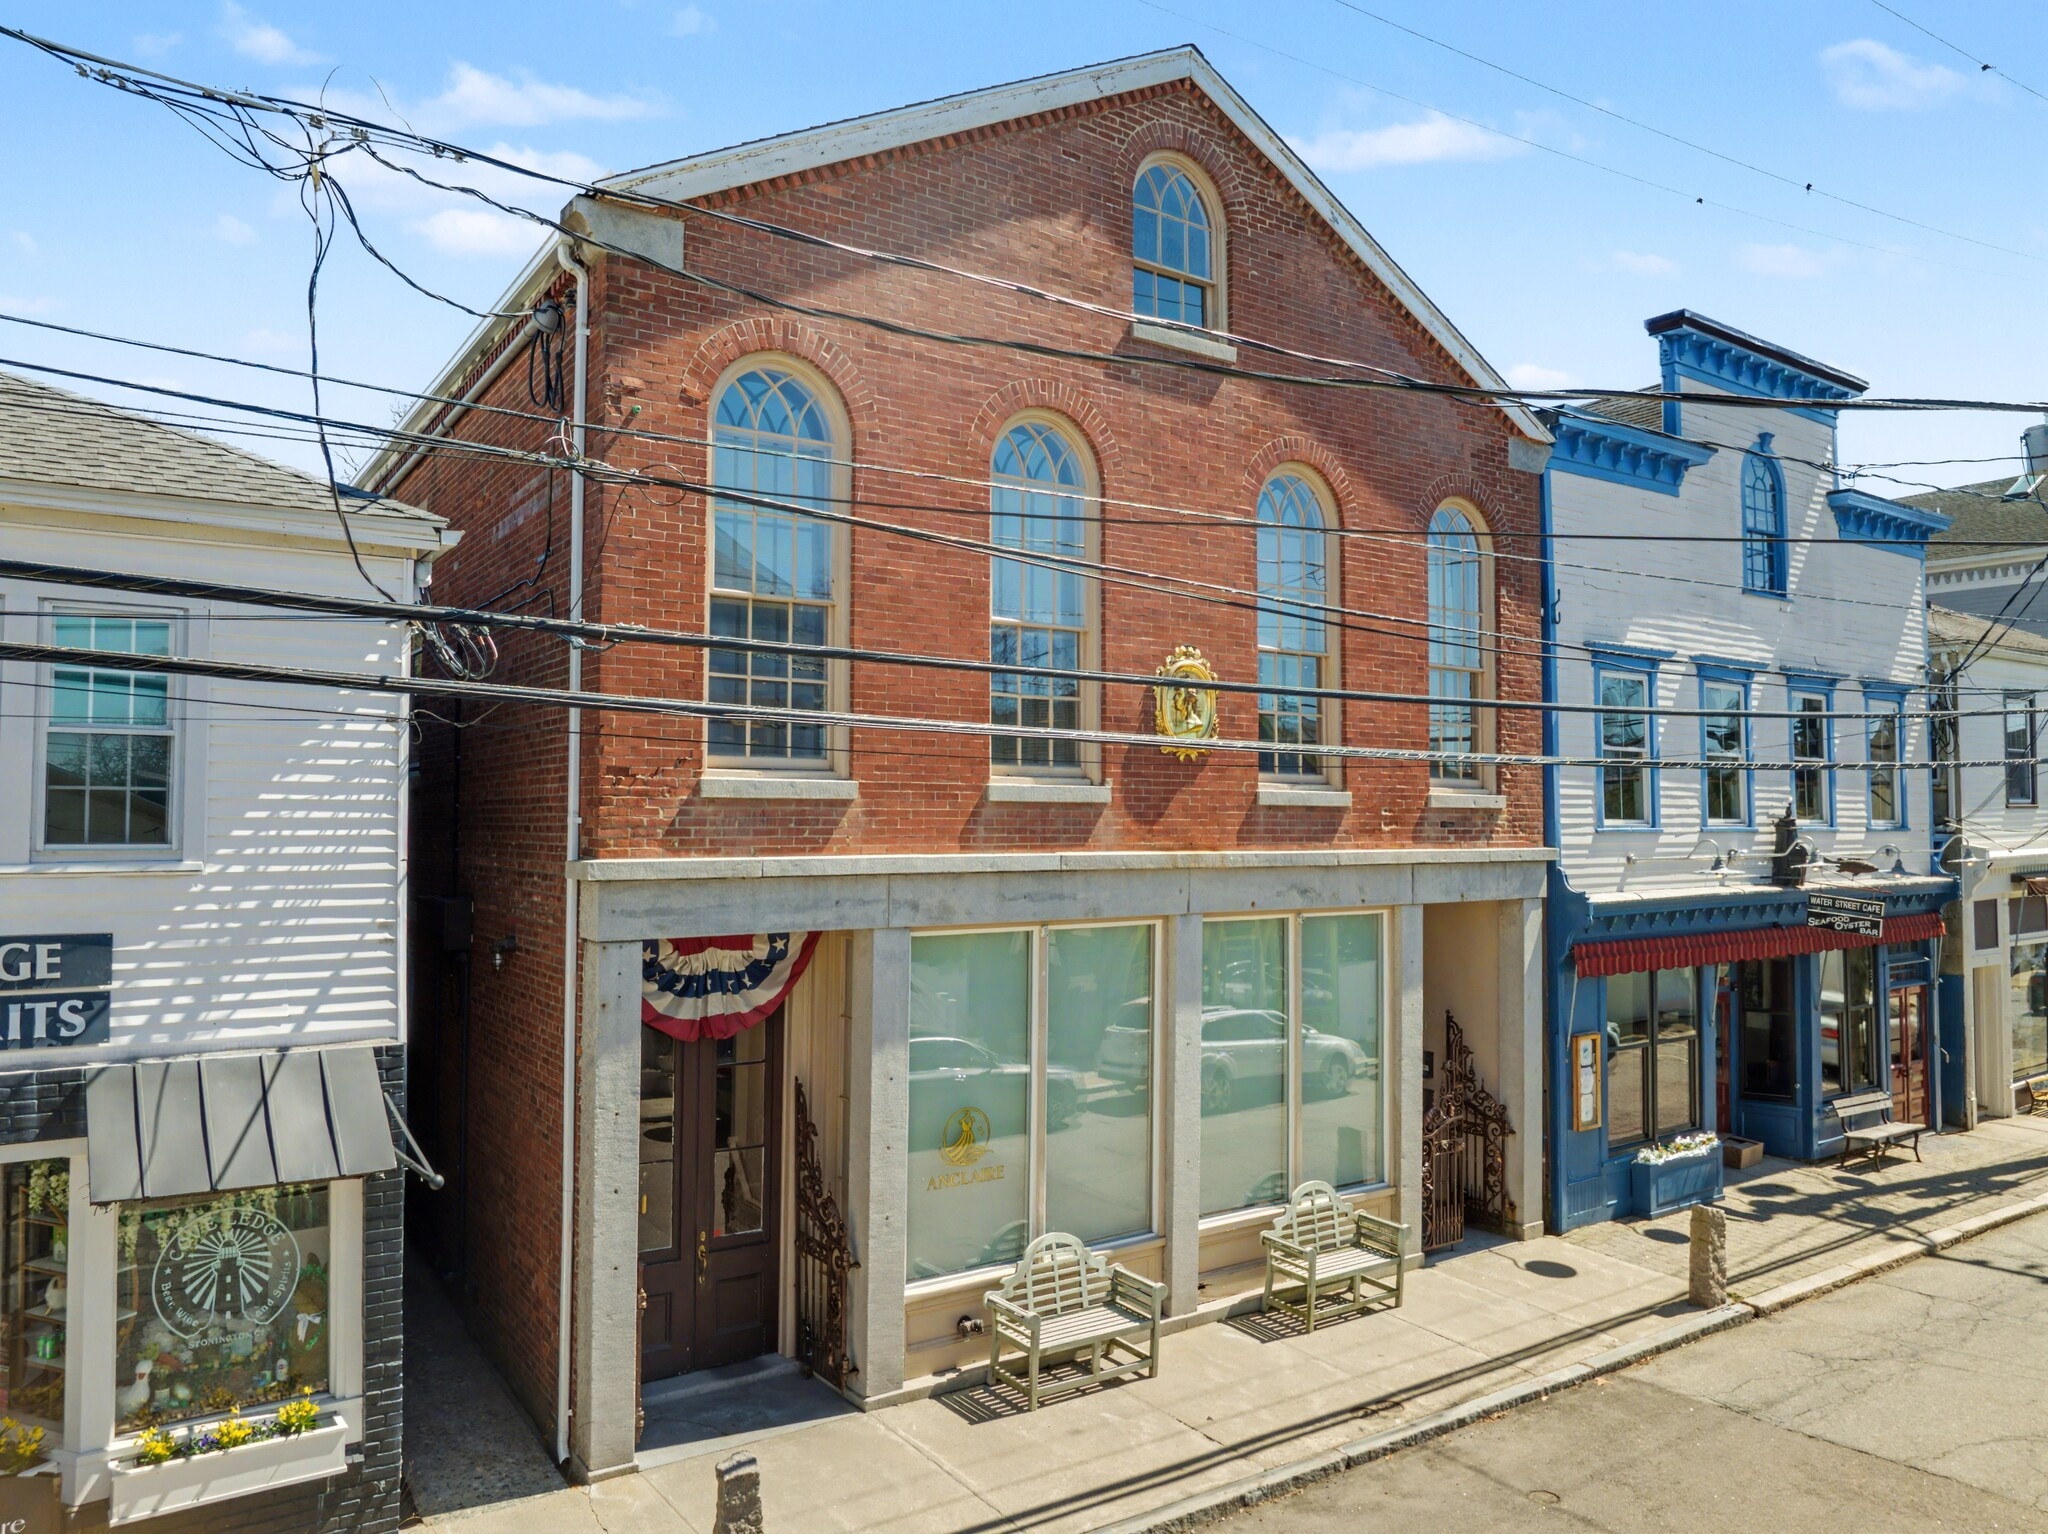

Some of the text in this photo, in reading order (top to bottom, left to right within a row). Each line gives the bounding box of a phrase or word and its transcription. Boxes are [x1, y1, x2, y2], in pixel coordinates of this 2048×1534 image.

[1810, 896, 1881, 914] WATER STREET CAFE
[1807, 916, 1850, 927] SEAFOOD
[1834, 920, 1871, 930] OYSTER
[1859, 928, 1879, 936] BAR
[0, 943, 61, 981] GE
[0, 1000, 86, 1040] ITS
[926, 1164, 1005, 1191] ANCLAIRE
[175, 1307, 200, 1327] Wine
